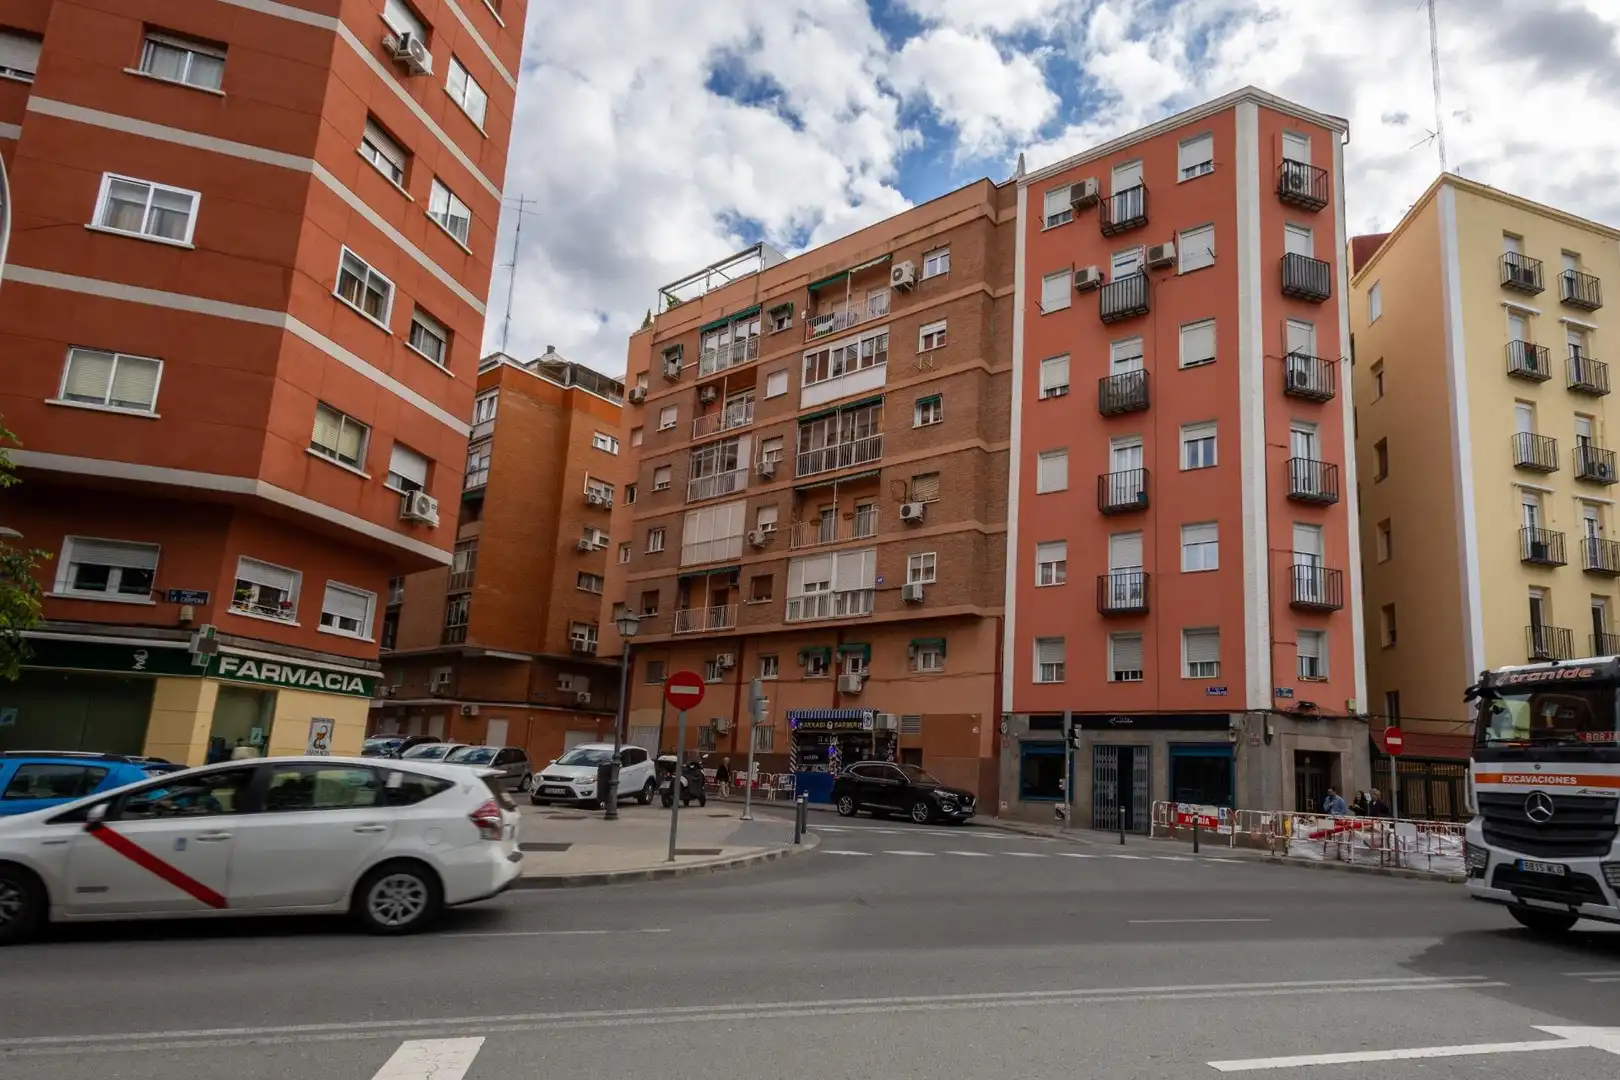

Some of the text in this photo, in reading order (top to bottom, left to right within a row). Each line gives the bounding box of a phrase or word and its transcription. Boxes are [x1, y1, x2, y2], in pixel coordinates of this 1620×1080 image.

[219, 657, 365, 693] FARMACIA
[1502, 775, 1577, 785] EXCAVACIONES
[1185, 815, 1210, 825] AVRÍA
